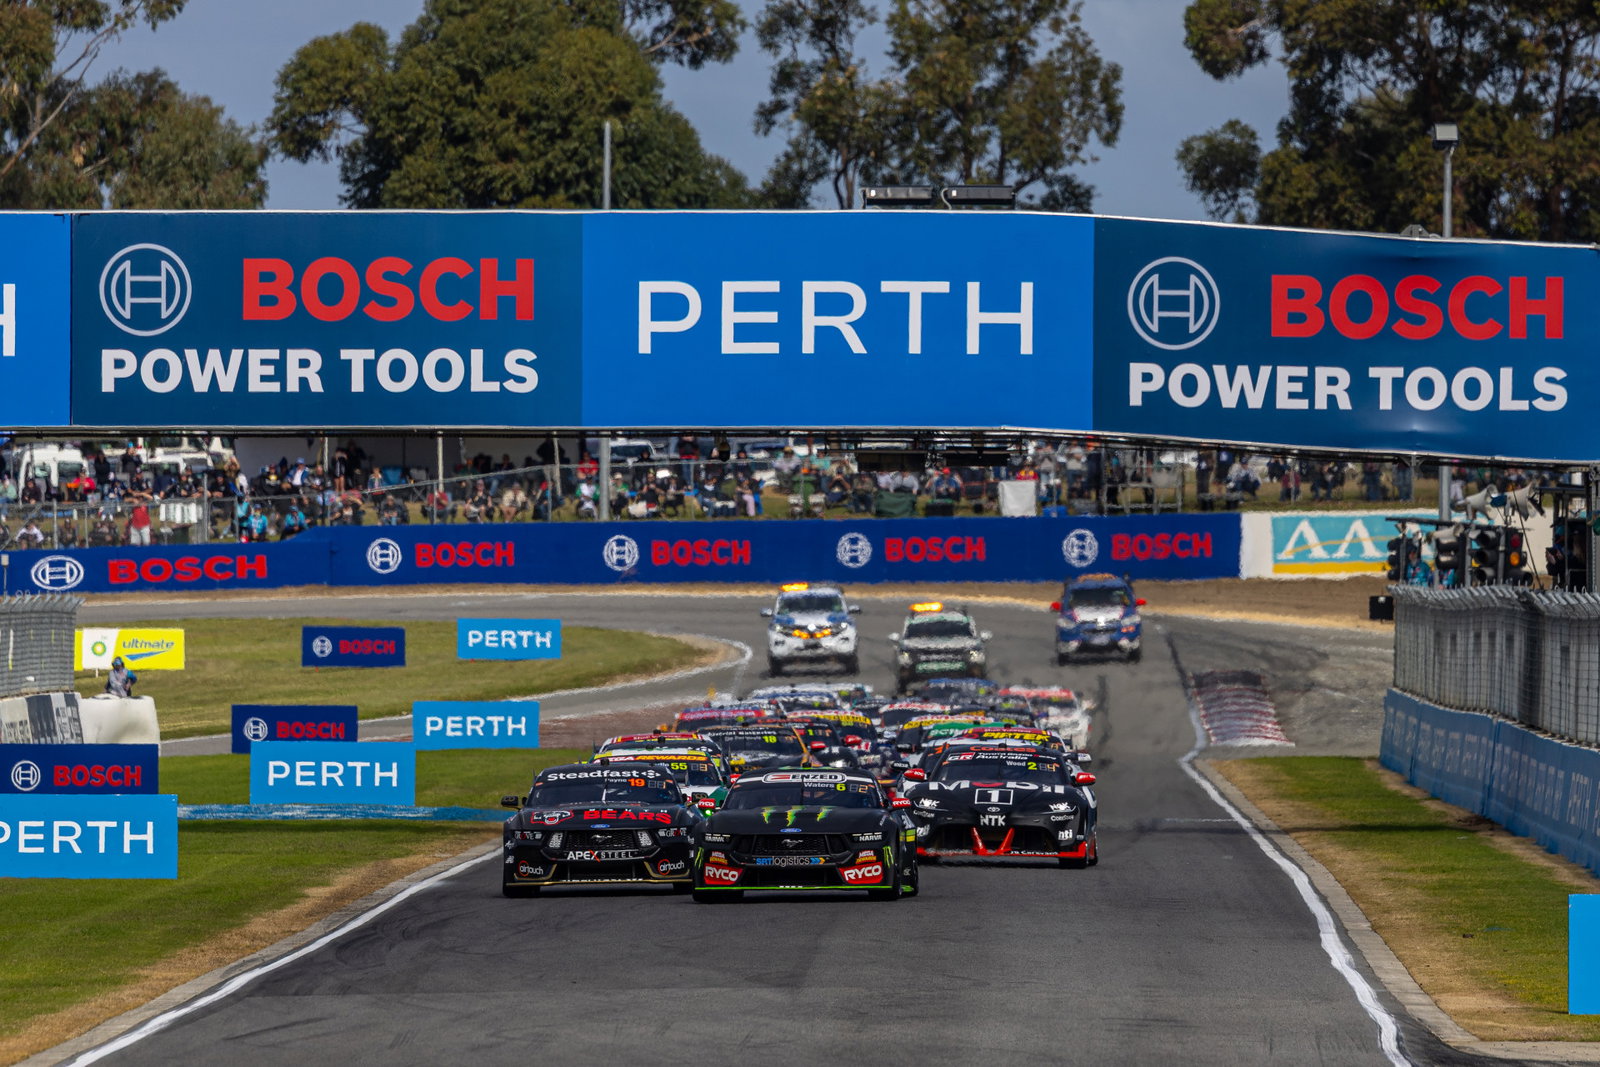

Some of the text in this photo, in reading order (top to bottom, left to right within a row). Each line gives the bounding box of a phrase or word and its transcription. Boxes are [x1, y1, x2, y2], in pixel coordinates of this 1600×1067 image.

[243, 257, 535, 321] BOSCH
[1271, 275, 1564, 340] BOSCH
[638, 281, 1034, 355] PERTH
[101, 348, 539, 393] POWER TOOLS
[1129, 363, 1568, 411] POWER TOOLS
[415, 542, 515, 567] BOSCH
[651, 540, 751, 566] BOSCH
[885, 537, 985, 562] BOSCH
[1112, 534, 1212, 559] BOSCH
[108, 555, 267, 584] BOSCH
[123, 638, 174, 649] ultimate
[339, 640, 395, 654] BOSCH
[469, 630, 551, 648] PERTH
[277, 721, 345, 738] BOSCH
[426, 716, 526, 737] PERTH
[268, 761, 398, 787] PERTH
[1027, 762, 1037, 770] 2
[53, 765, 141, 787] BOSCH
[547, 770, 640, 781] Steadfast
[628, 778, 646, 787] 19
[836, 783, 847, 791] 6
[986, 790, 1000, 803] 1
[583, 810, 672, 825] BEARS
[980, 814, 1006, 827] NTK
[566, 850, 633, 863] APEX STEEL
[705, 866, 739, 882] RYCO
[844, 865, 882, 881] RYCO
